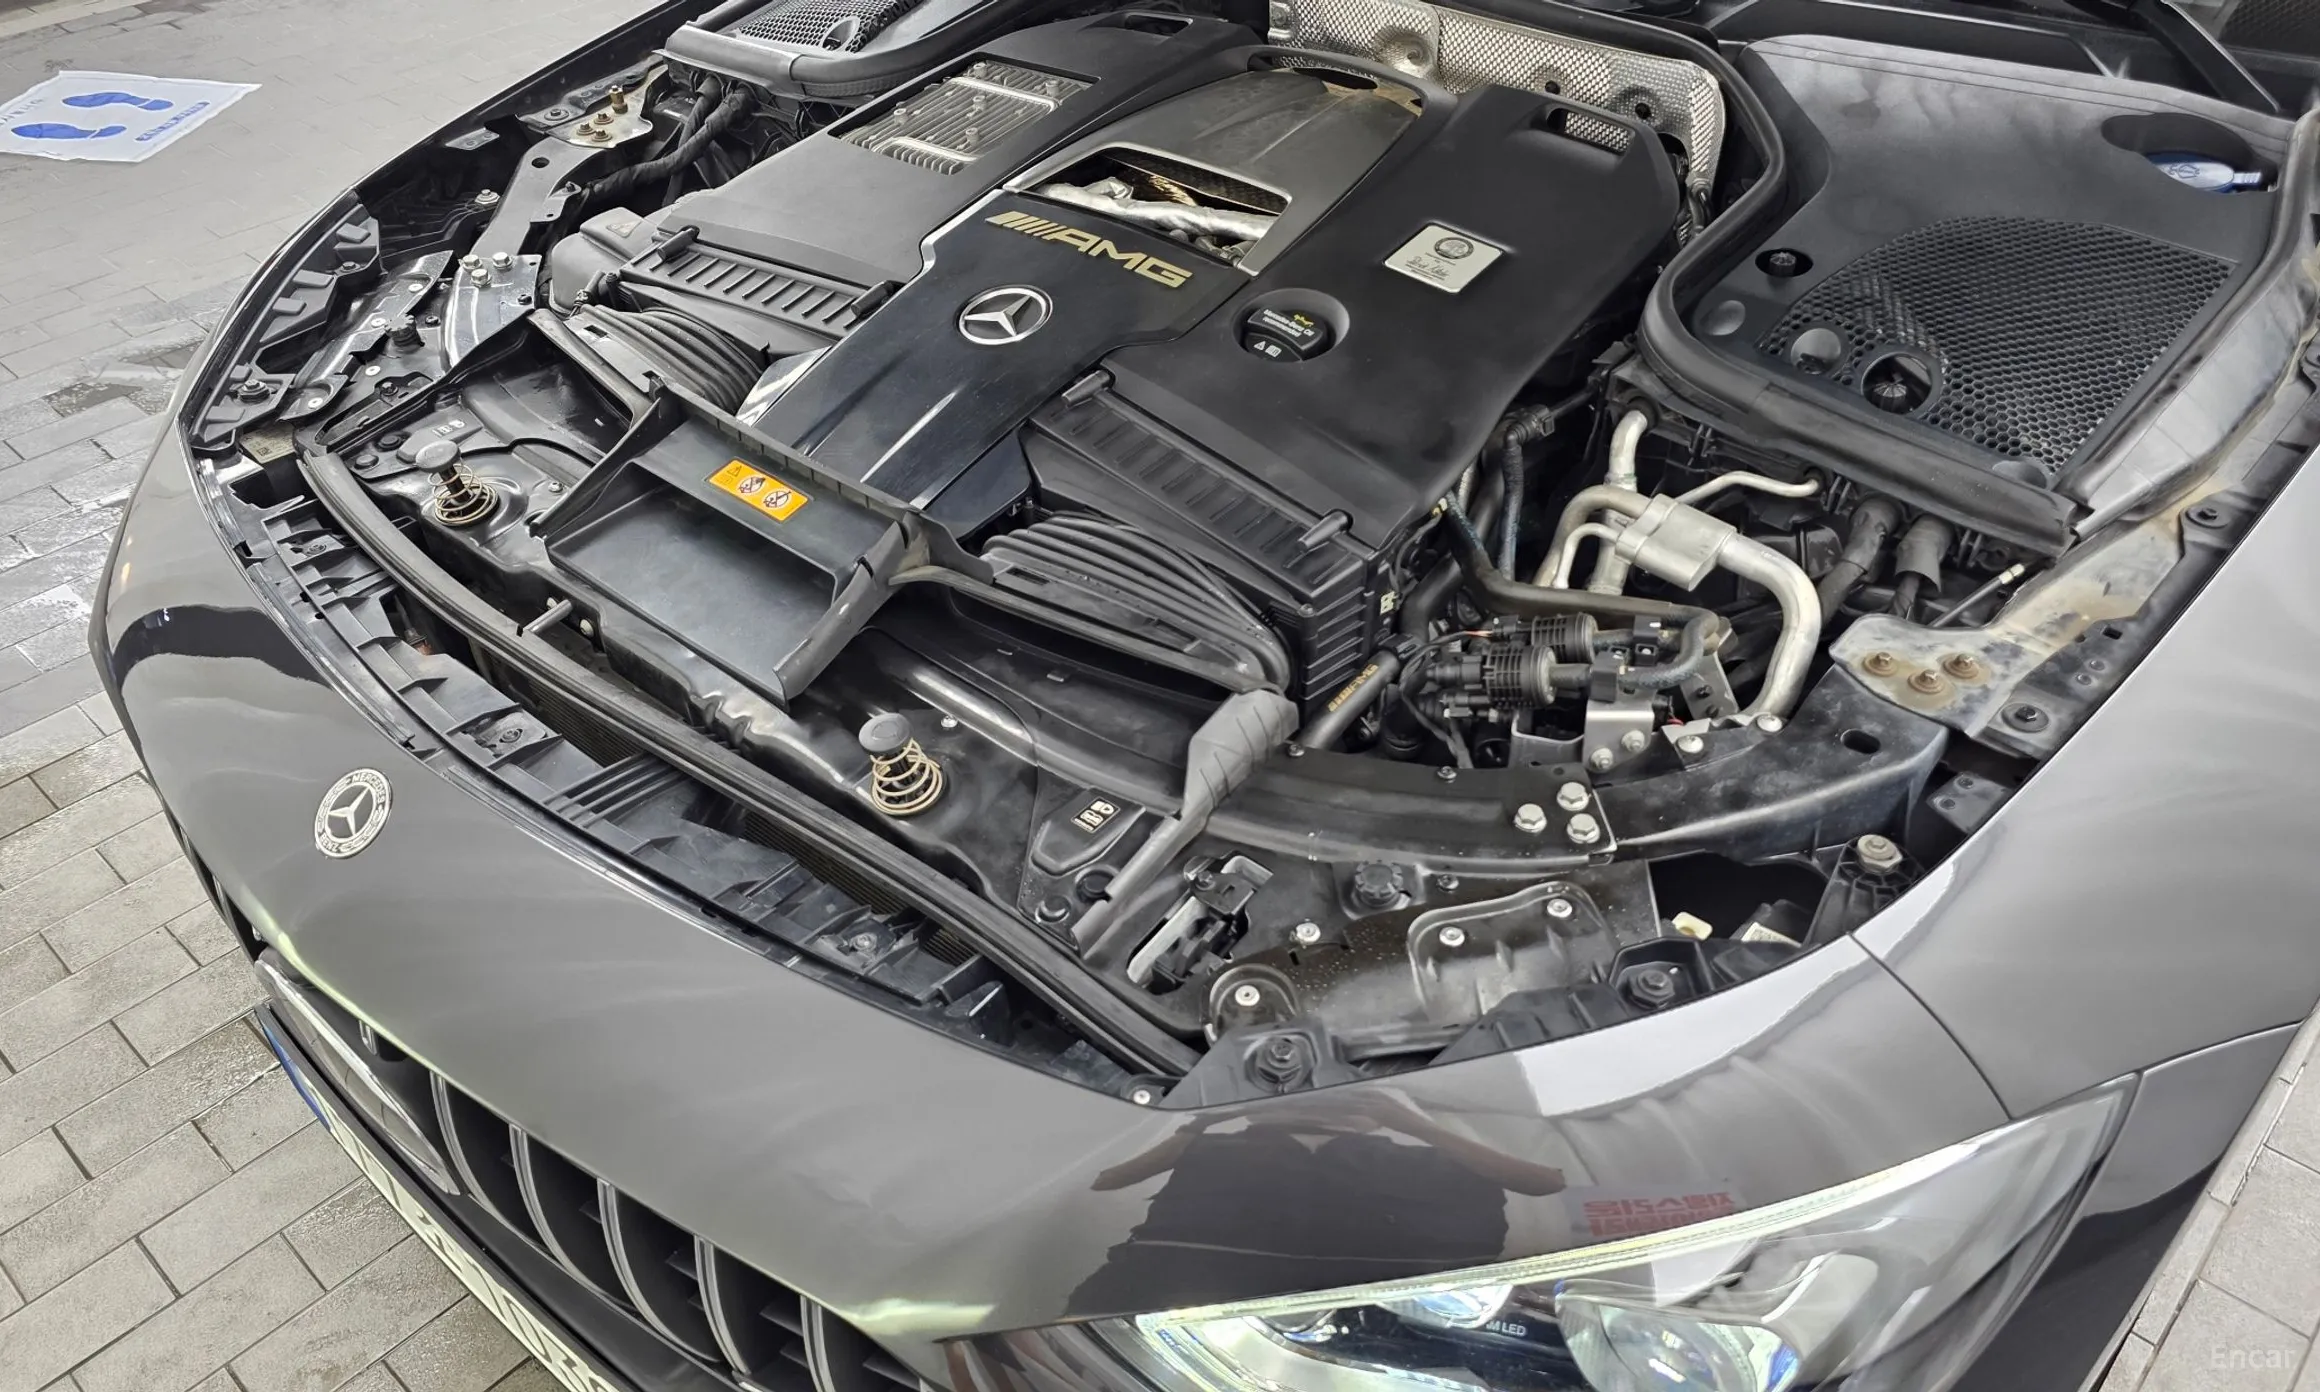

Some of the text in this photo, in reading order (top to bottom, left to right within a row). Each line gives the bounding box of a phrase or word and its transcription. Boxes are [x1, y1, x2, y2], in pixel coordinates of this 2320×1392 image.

[1044, 227, 1193, 288] AMG
[351, 772, 386, 804] MERCEDES
[320, 833, 340, 852] BENZ
[463, 1255, 608, 1392] 103
[1501, 1322, 1527, 1337] LED
